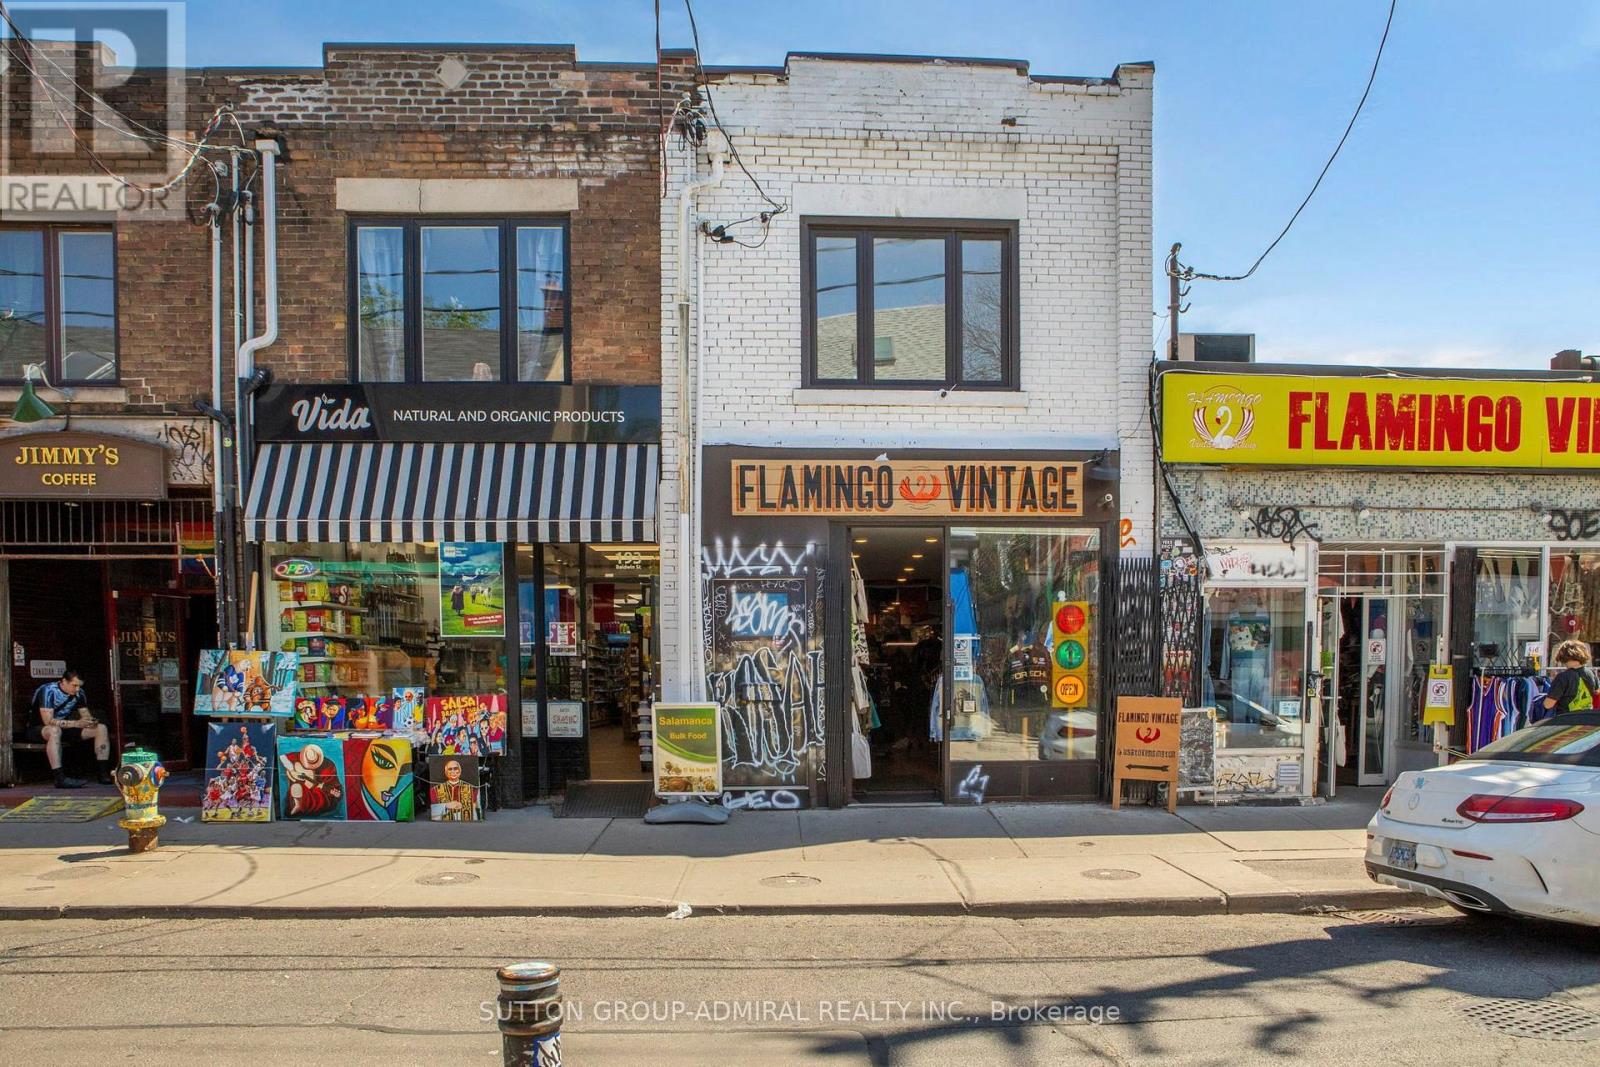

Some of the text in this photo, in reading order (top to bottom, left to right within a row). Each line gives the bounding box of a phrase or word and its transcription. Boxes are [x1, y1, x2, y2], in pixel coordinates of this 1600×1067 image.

[291, 393, 371, 432] Vida
[393, 409, 625, 423] NATURAL AND ORGANIC PRODUCTS
[1288, 391, 1600, 454] FLAMINGO VI
[15, 444, 119, 465] JIMMY'S
[42, 473, 96, 486] COFFEE
[736, 464, 1077, 512] FLAMINGO VINTAGE
[616, 552, 642, 564] 193
[276, 564, 314, 575] OPEN
[1061, 683, 1079, 696] OPEN
[441, 696, 476, 709] SALSA
[659, 717, 713, 726] Salamanca
[1118, 712, 1178, 724] FLAMINGO VINTAGE
